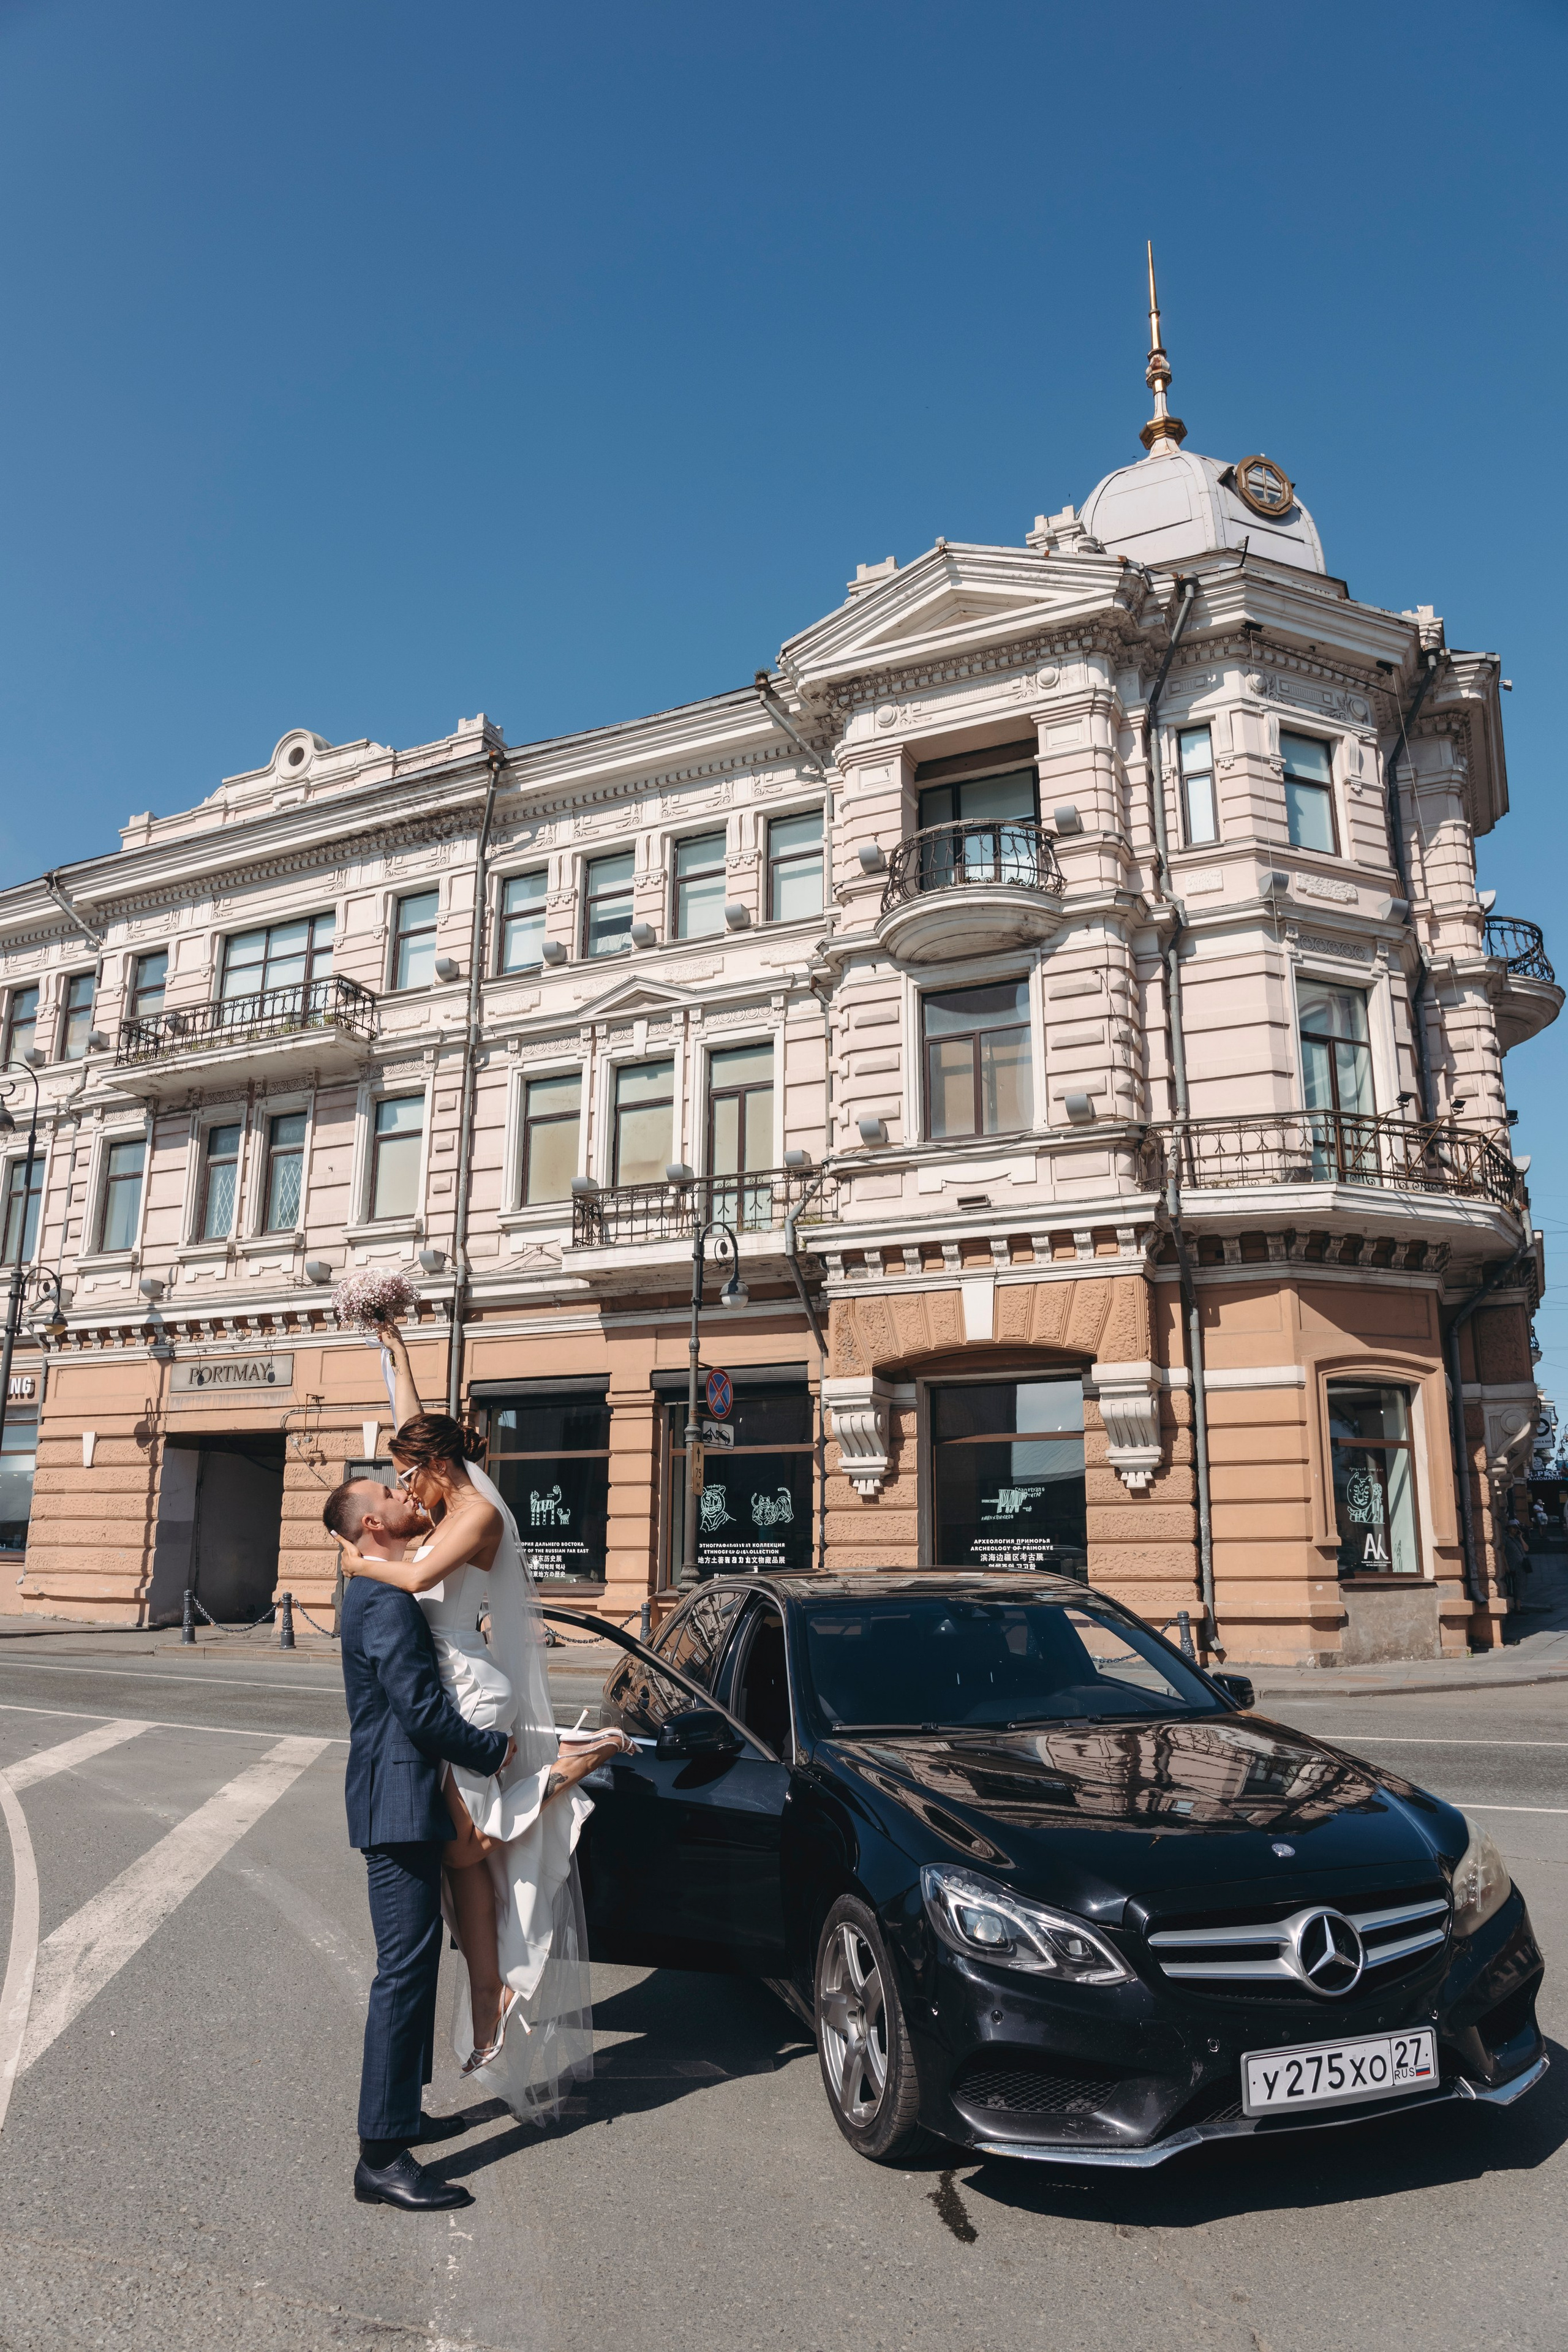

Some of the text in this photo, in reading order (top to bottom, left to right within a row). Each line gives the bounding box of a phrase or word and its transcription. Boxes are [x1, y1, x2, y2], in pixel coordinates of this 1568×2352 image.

[189, 1362, 271, 1384] PORTMAY
[10, 1376, 32, 1394] NG
[695, 1468, 702, 1479] 75
[1394, 2037, 1421, 2069] 27
[1394, 2067, 1415, 2080] RUS
